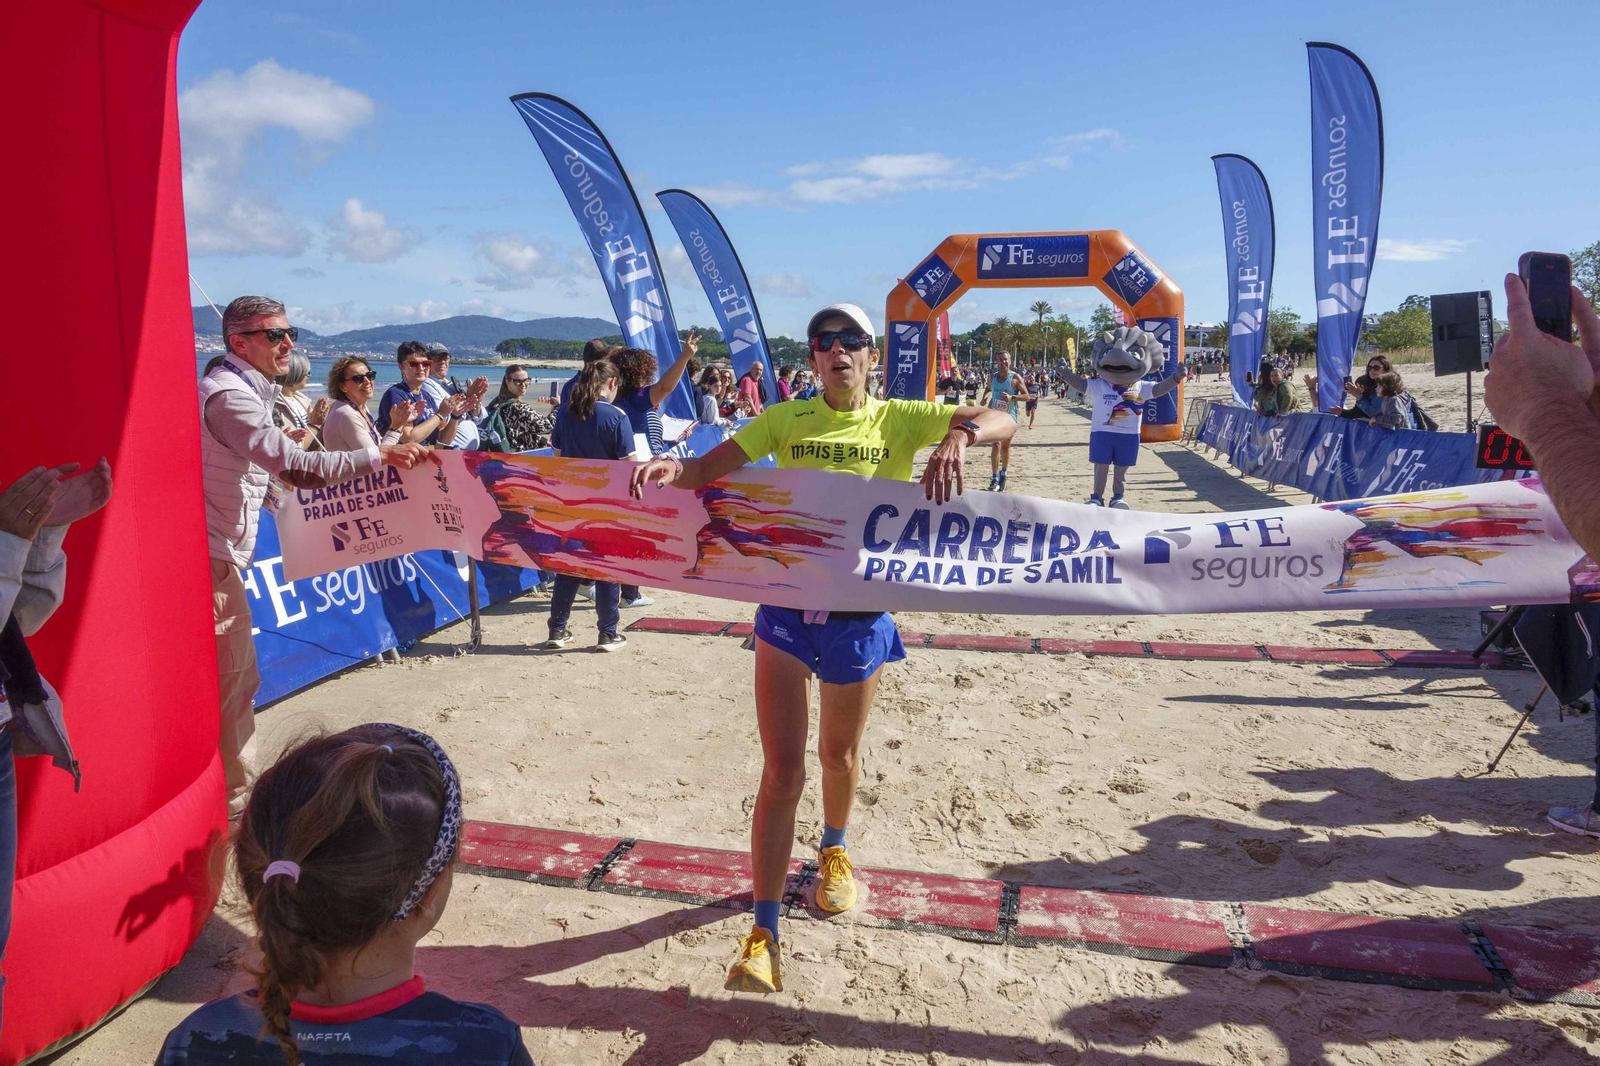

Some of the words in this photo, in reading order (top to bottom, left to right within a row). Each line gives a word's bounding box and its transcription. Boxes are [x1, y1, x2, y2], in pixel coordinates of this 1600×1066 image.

[1006, 244, 1034, 265] FE
[1036, 253, 1084, 268] seguros
[924, 266, 945, 285] FE
[929, 270, 953, 294] seguros
[1119, 273, 1145, 297] seguros
[1129, 266, 1149, 288] FE
[898, 347, 919, 374] FE
[791, 441, 830, 460] máis
[833, 443, 846, 463] que
[848, 446, 890, 465] auga
[303, 500, 345, 522] PRAIA
[347, 497, 365, 512] DE
[367, 487, 409, 509] SAMIL
[352, 516, 389, 541] FE
[434, 512, 465, 529] SAMIL
[1205, 516, 1292, 549] FE
[353, 533, 404, 555] seguros
[862, 503, 1122, 565] CARREIRA
[863, 557, 968, 585] PRAIA
[975, 566, 1015, 587] DE
[1022, 555, 1123, 585] SAMIL
[1190, 551, 1324, 589] seguros
[312, 552, 417, 615] seguros
[296, 1032, 352, 1042] NAFFTA
